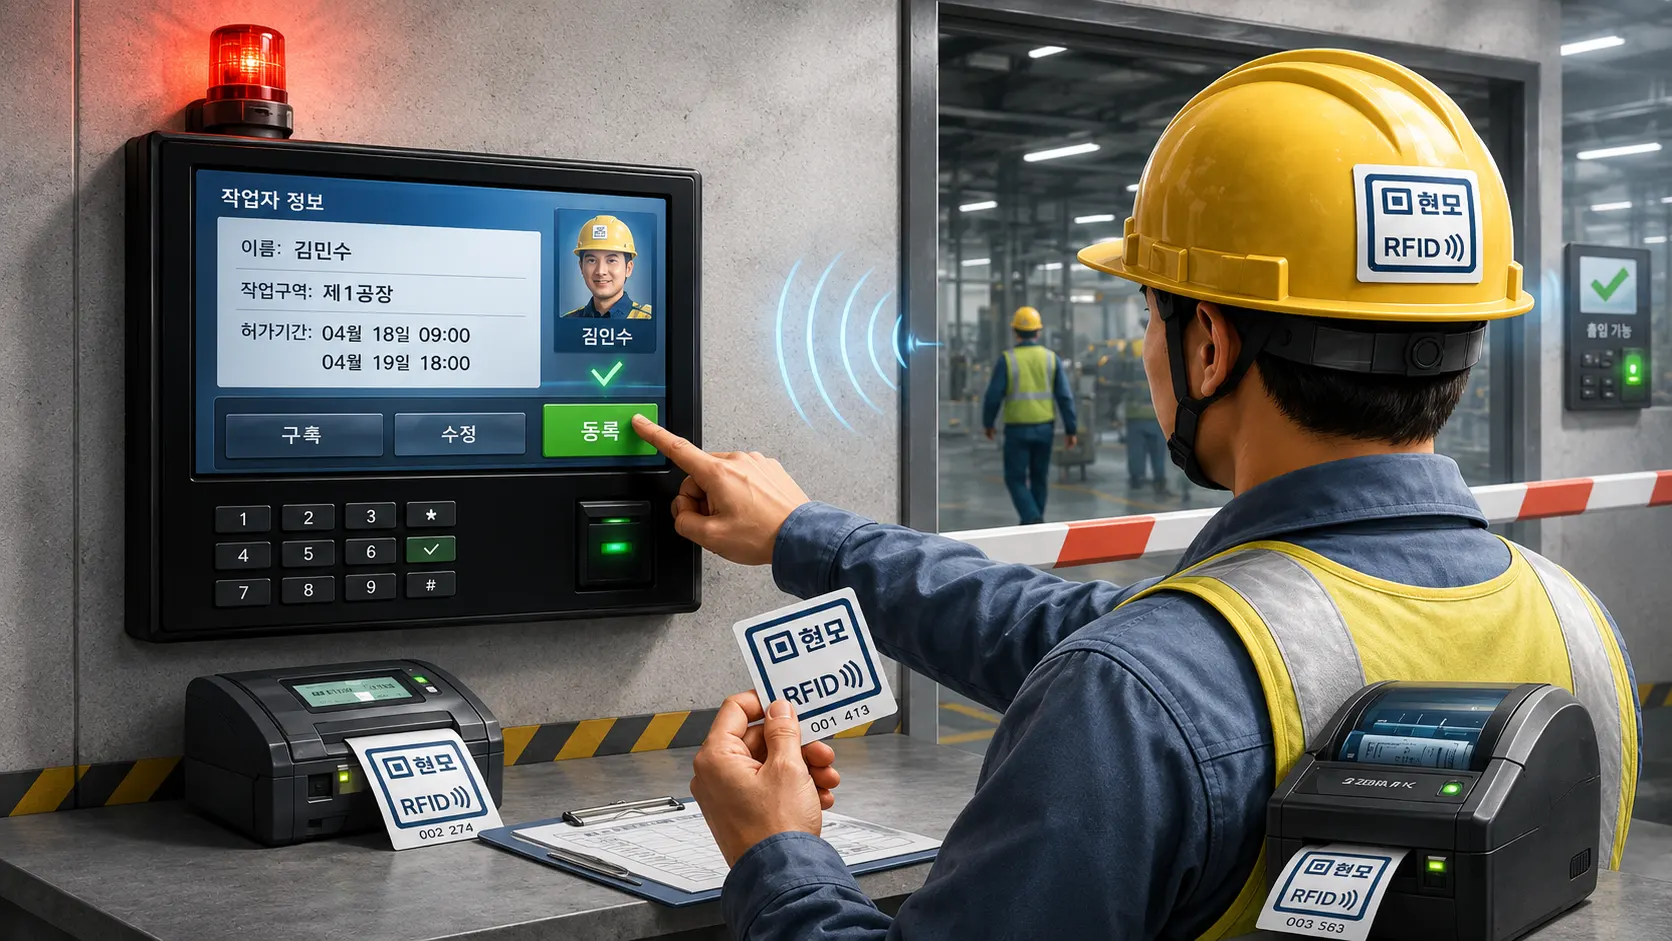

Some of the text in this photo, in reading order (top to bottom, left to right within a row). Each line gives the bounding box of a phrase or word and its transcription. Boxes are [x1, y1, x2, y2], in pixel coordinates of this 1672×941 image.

[221, 188, 324, 211] 작업자 정보
[1417, 191, 1462, 215] 현모
[241, 239, 352, 261] 이름: 김민수
[1384, 237, 1441, 258] RFID
[240, 282, 393, 304] 작업구역: 제1공장
[241, 322, 470, 343] 허가기간: 04월 18일 09:00
[1611, 323, 1632, 339] 가능
[322, 354, 470, 372] 04월 19일 18:00
[441, 425, 476, 443] 수정
[581, 421, 620, 442] 동록
[239, 512, 247, 526] 1
[304, 511, 314, 525] 2
[366, 510, 376, 523] 3
[238, 545, 376, 563] 4 5 6
[238, 586, 249, 600] 7
[303, 583, 314, 597] 8
[366, 580, 376, 594] 9
[798, 618, 849, 653] 현모
[782, 674, 840, 706] RFID
[810, 716, 837, 733] 001
[412, 754, 457, 775] 현모
[400, 793, 450, 816] RFID
[419, 823, 474, 840] 002 274
[1290, 888, 1336, 906] RFID
[1286, 917, 1314, 929] 003
